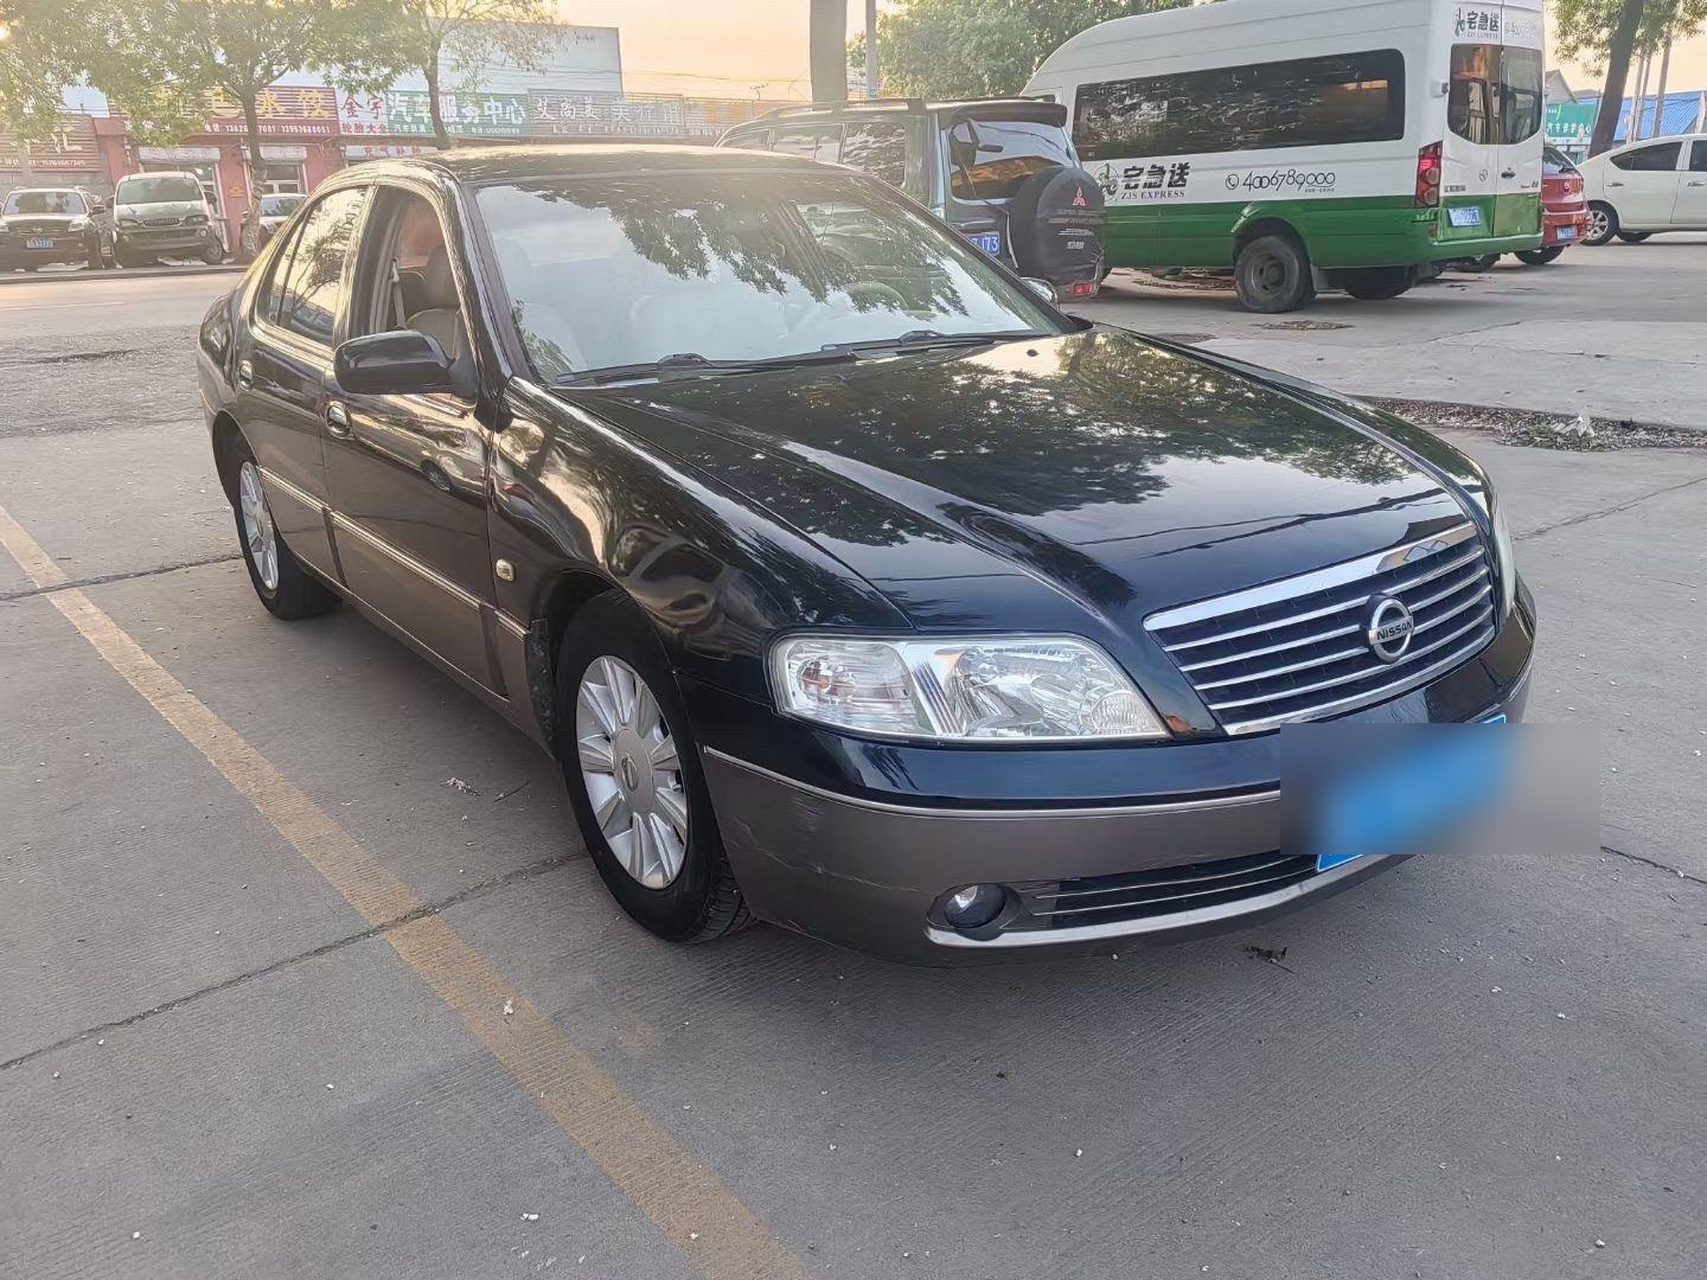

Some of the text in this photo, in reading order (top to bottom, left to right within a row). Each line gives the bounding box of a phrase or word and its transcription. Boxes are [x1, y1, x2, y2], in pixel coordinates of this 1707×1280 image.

[1467, 10, 1499, 31] 宅急送
[388, 92, 526, 125] 汽车服务中心
[341, 122, 387, 133] 轮胎大全
[1122, 162, 1190, 190] 宅急送
[1242, 169, 1336, 192] 4006789000
[1121, 190, 1185, 200] ZJS EXPRESS
[1376, 621, 1412, 640] NISSAN
